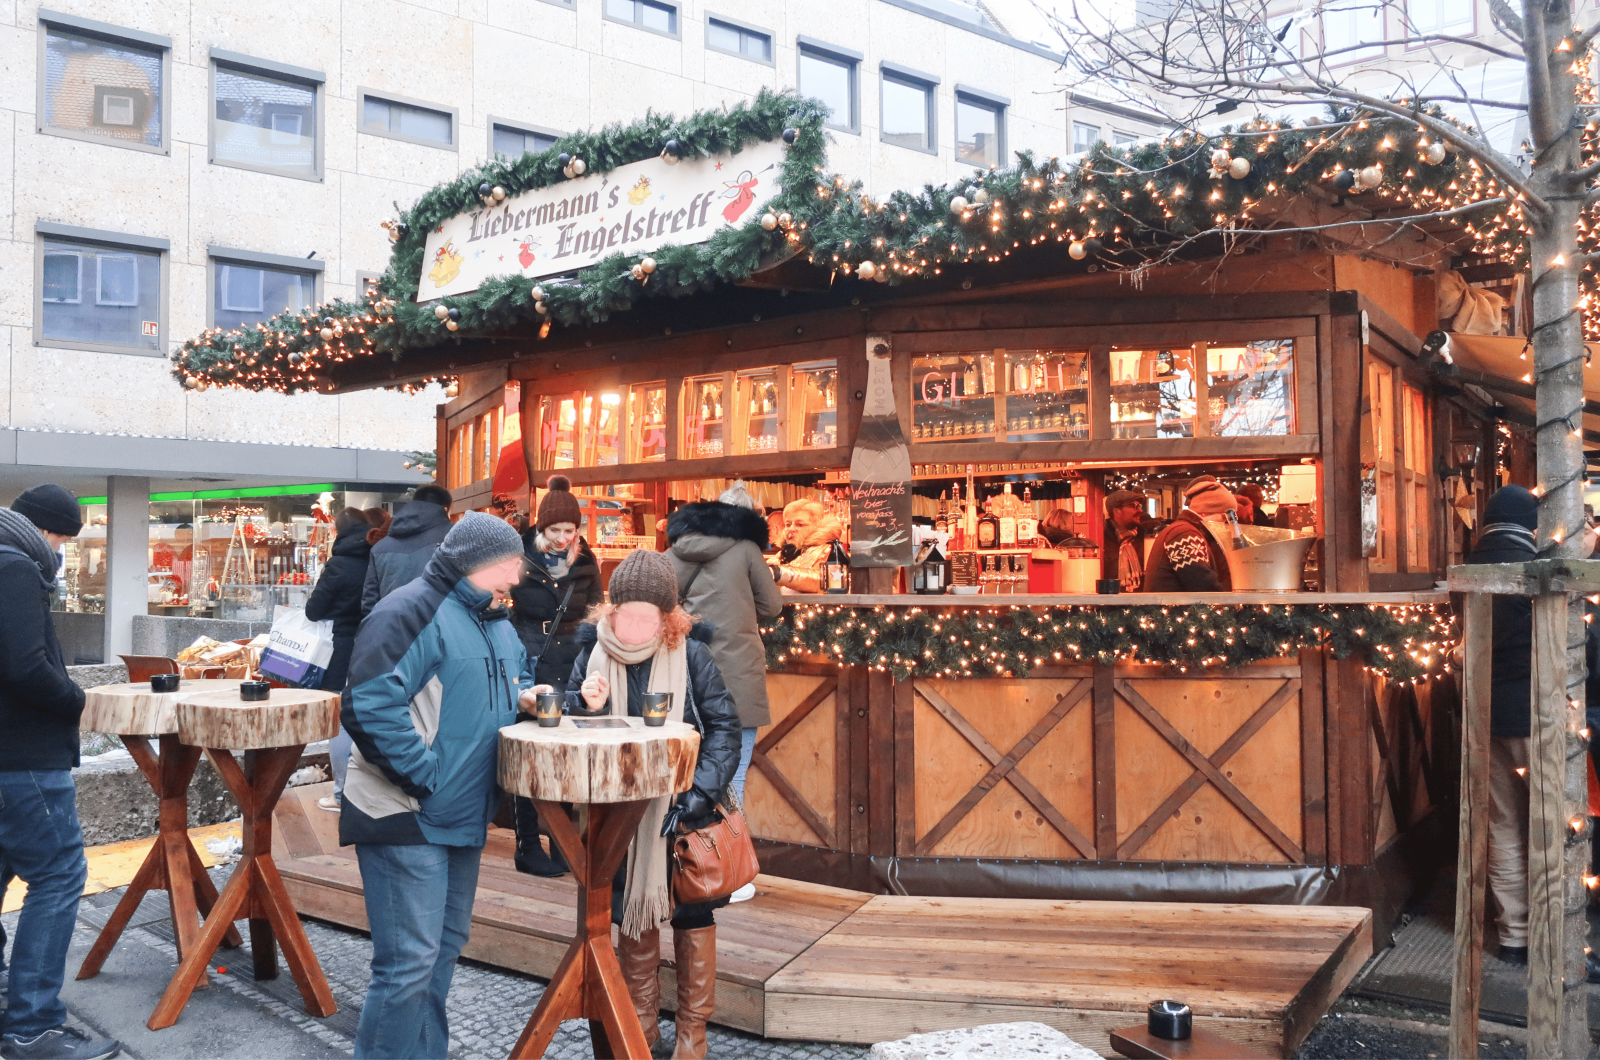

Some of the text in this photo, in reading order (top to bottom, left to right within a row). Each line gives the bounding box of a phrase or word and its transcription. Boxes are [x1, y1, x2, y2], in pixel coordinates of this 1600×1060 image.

[466, 178, 620, 243] Liebermann's
[552, 190, 716, 260] Engelstreff
[863, 498, 888, 509] bier
